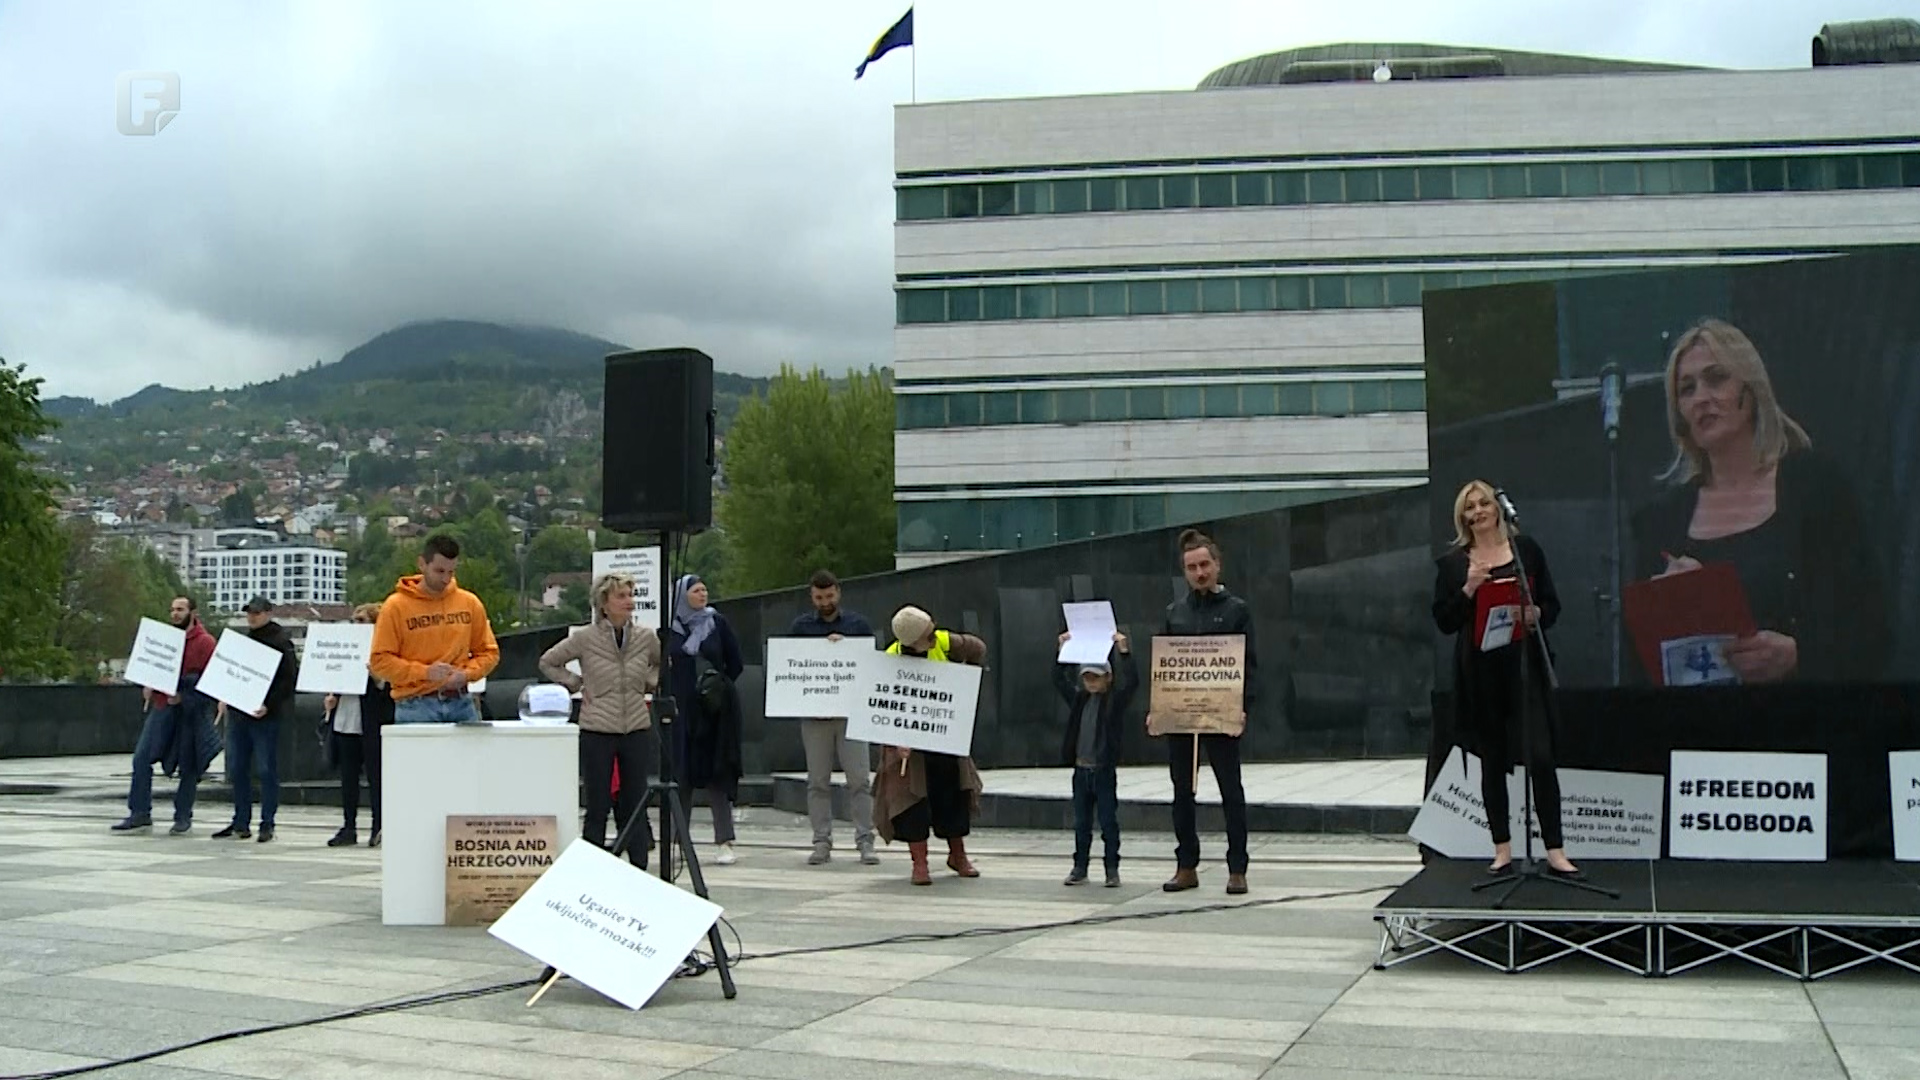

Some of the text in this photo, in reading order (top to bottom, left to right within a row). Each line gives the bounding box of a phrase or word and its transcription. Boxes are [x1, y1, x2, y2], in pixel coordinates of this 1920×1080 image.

[831, 659, 843, 668] da
[1160, 656, 1237, 668] BOSNIA AND
[896, 669, 936, 684] SVAKIH
[1153, 669, 1242, 682] HERZEGOVINA
[803, 686, 840, 696] prava!!!
[875, 683, 953, 703] 10 SEKUNDI
[868, 697, 956, 719] UMRE 1 DIJETE
[871, 714, 948, 735] OD GLADI!!!
[1679, 779, 1815, 800] #FREEDOM
[1431, 792, 1460, 814] škole
[1577, 807, 1625, 818] ZDRAVE
[1680, 812, 1814, 833] #SLOBODA
[454, 840, 547, 851] BOSNIA AND
[447, 855, 553, 868] HERZEGOVINA
[579, 893, 626, 923] Ugasite
[545, 899, 657, 960] uključite mozak!!!
